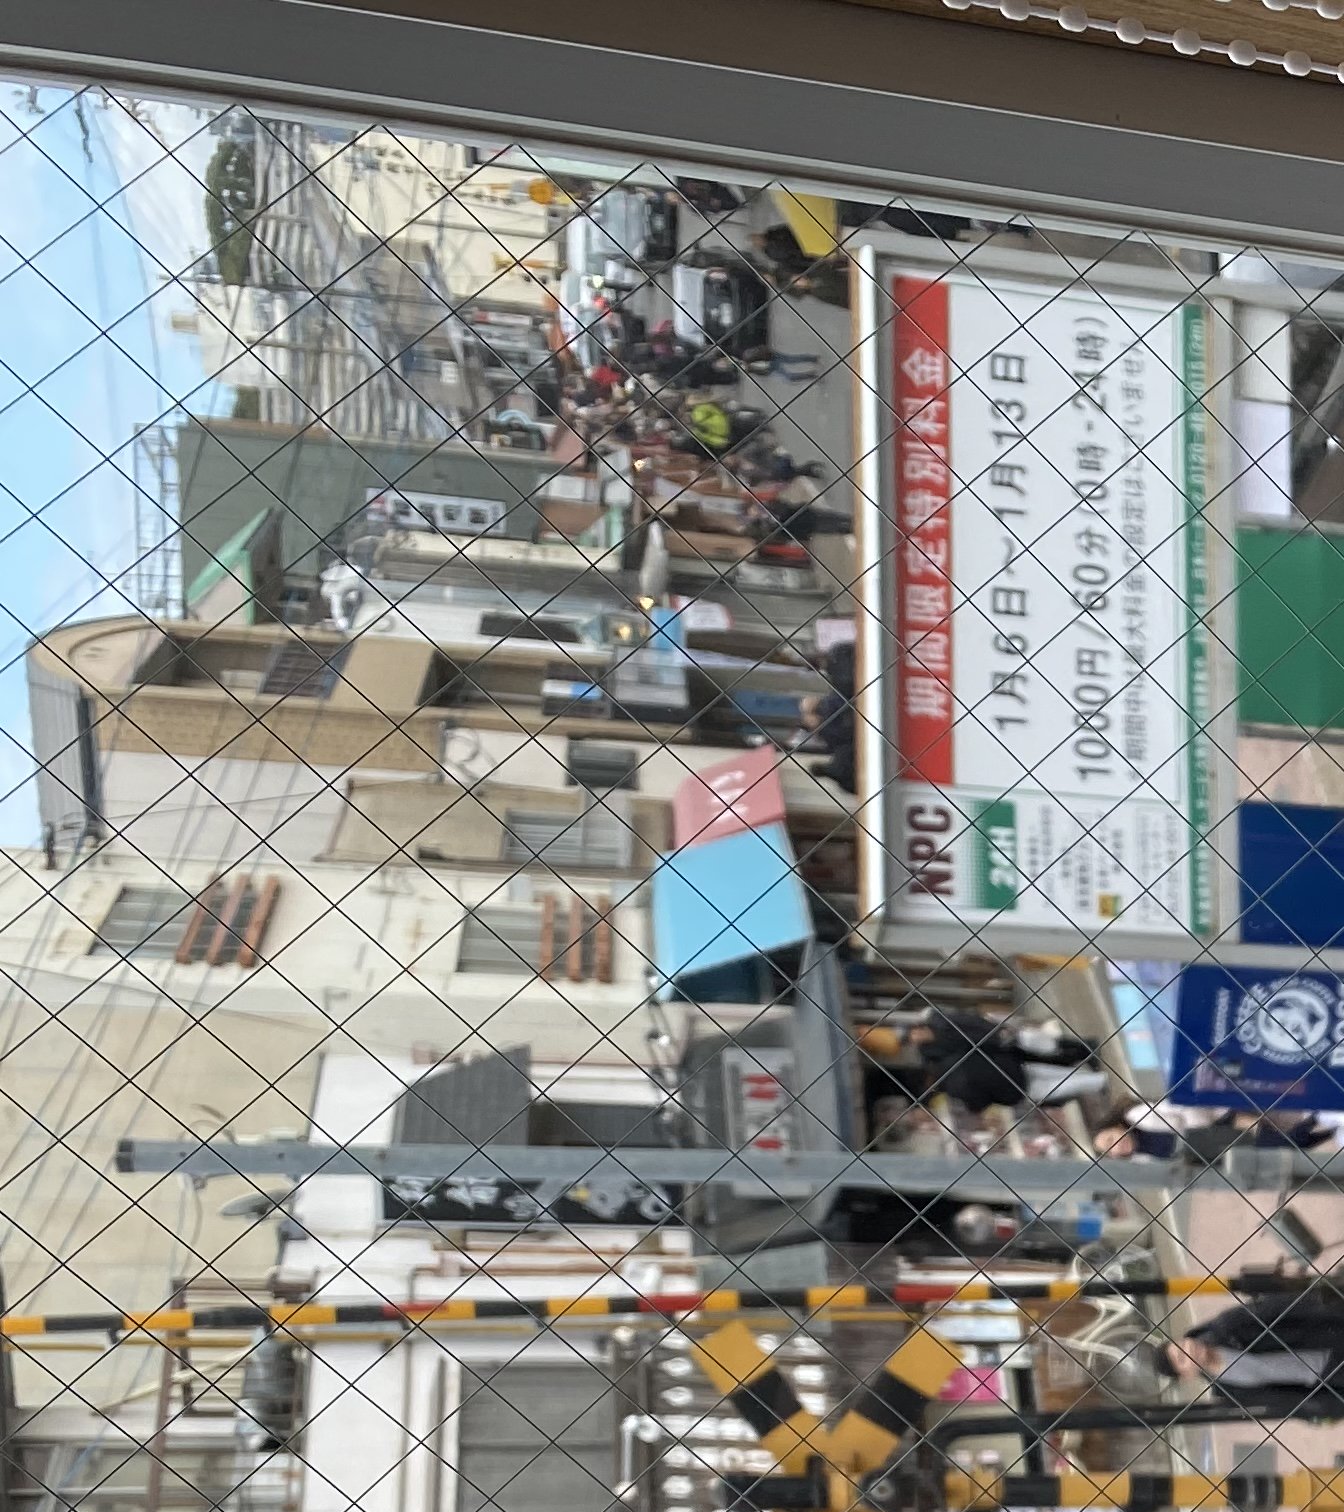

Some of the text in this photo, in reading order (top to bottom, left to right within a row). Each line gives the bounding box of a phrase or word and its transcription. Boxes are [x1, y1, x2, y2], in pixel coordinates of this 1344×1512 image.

[901, 347, 948, 719] 期間限定特別料金
[906, 806, 953, 896] NPC
